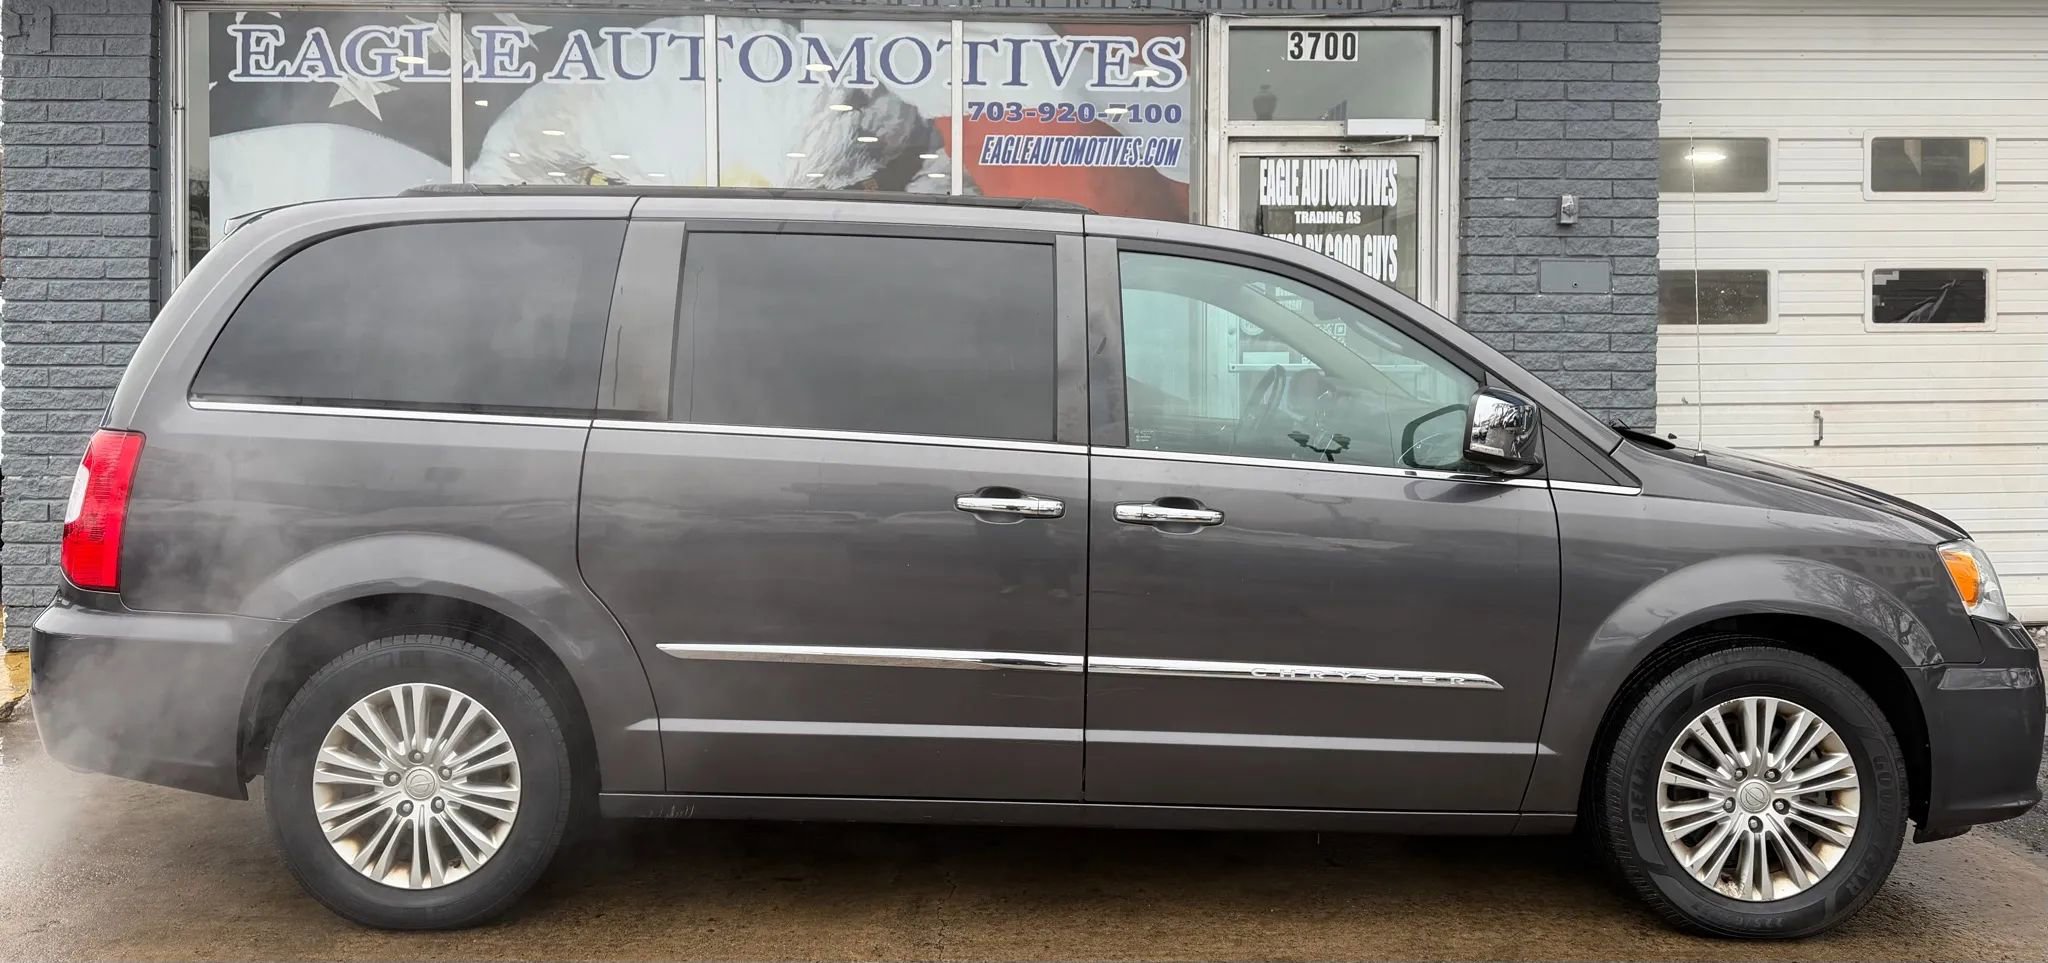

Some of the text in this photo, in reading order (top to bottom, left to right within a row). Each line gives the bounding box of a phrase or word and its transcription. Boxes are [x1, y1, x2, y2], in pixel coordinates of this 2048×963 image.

[228, 24, 1188, 92] EAGLE AUTOMOTIVES
[1289, 31, 1357, 60] 3700
[967, 101, 1183, 124] 703-920-7100
[980, 135, 1182, 167] EAGLEAUTOMOTIVES.COM
[1259, 158, 1398, 207] EAGLE AUTOMOTIVES
[1294, 211, 1361, 224] TRADING AS
[1363, 233, 1398, 282] GUYS
[1250, 668, 1466, 685] CHRYSLER
